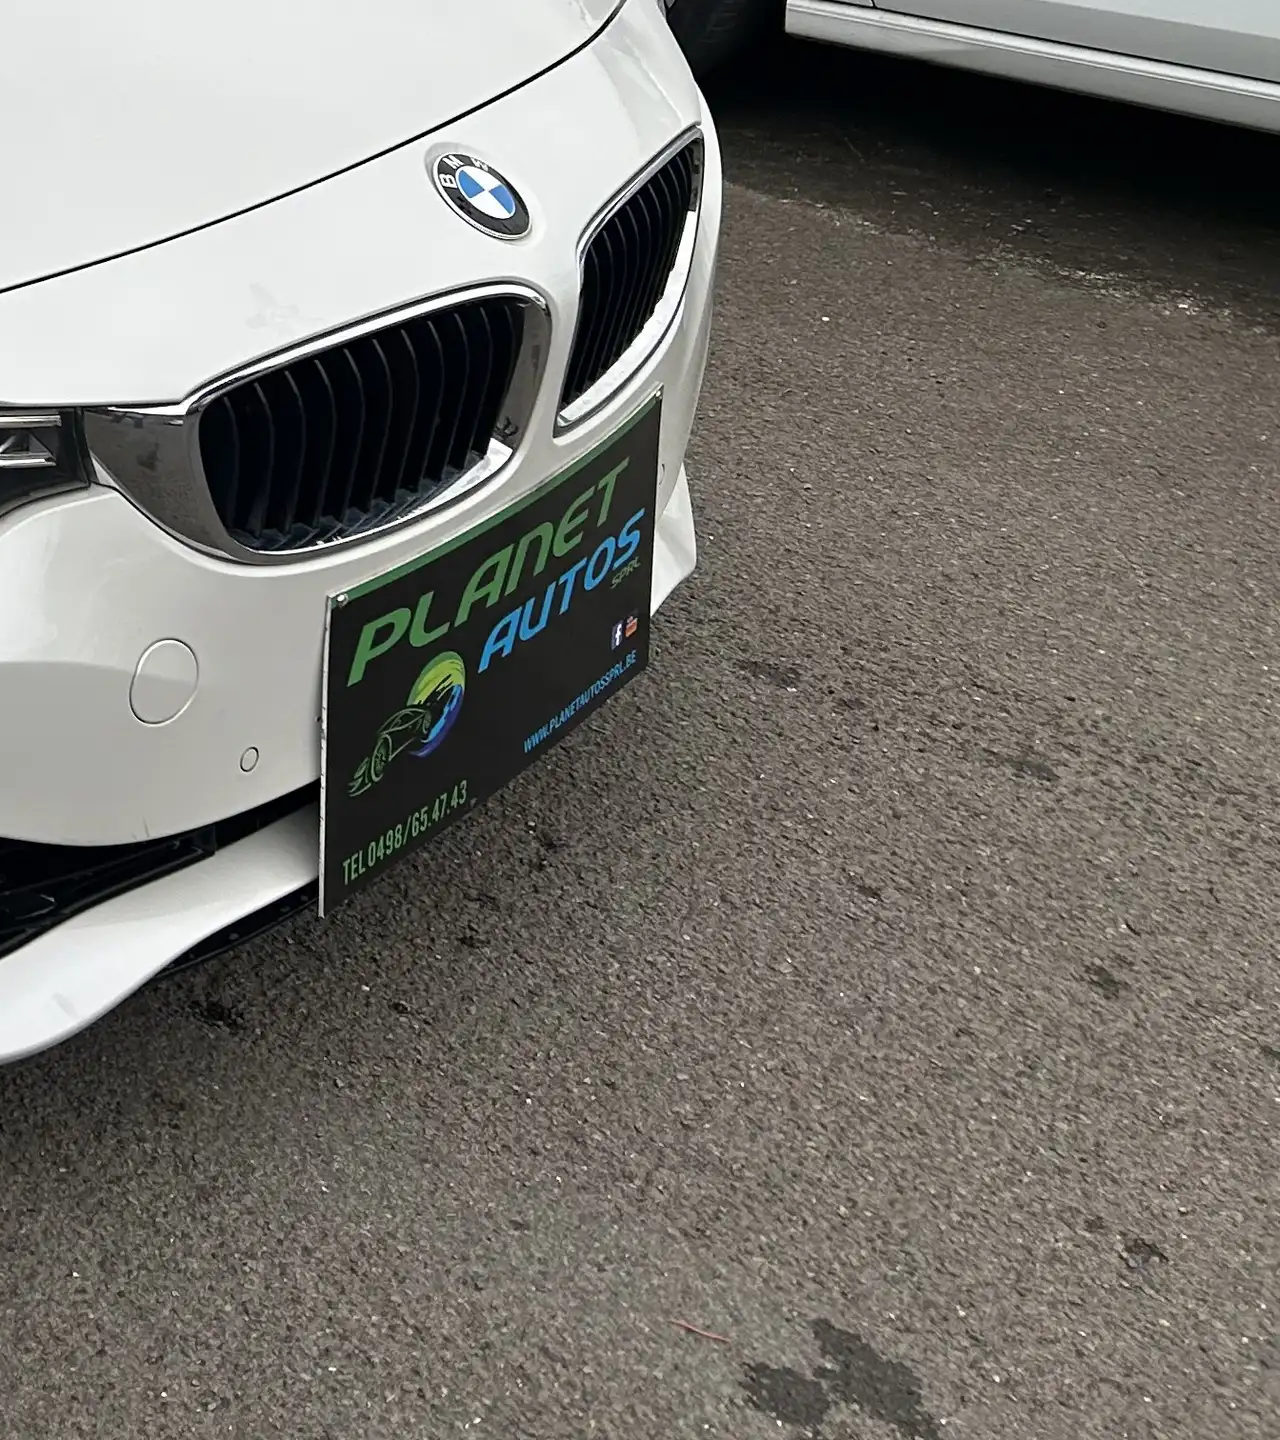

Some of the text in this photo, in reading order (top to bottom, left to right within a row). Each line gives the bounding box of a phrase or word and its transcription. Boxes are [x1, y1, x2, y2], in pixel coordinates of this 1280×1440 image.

[439, 155, 488, 188] BMW
[347, 458, 630, 687] PLANET
[478, 508, 645, 673] AUTOS
[610, 556, 640, 589] SPRL
[524, 650, 636, 753] WWW.PLANETAUTOSSPRL.BE
[343, 779, 467, 885] TEL 0498/65.47.43
